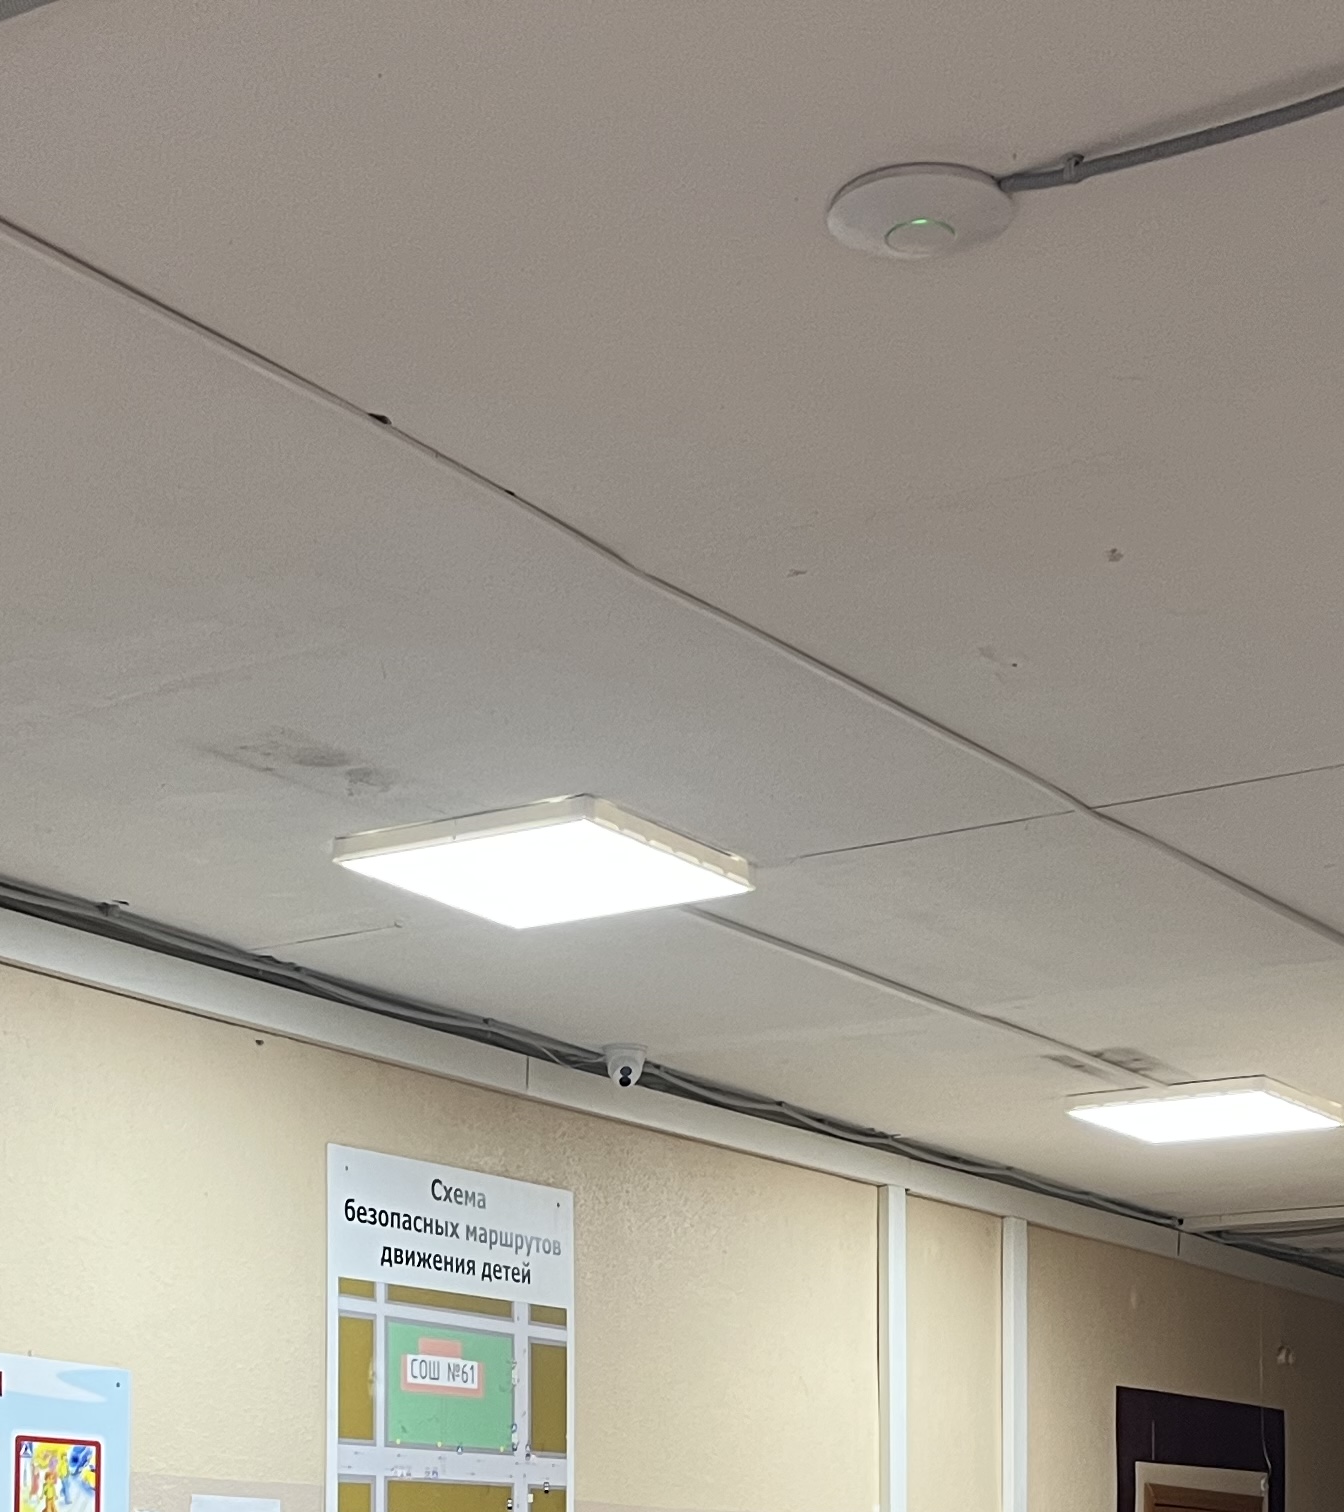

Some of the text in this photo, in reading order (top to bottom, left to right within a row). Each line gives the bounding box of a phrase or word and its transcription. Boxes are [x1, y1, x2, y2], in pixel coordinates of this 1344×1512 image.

[431, 1178, 487, 1210] Схема
[344, 1198, 562, 1257] безопасных маршрутов
[380, 1245, 531, 1285] движения детей
[410, 1358, 475, 1384] СОШ №61
